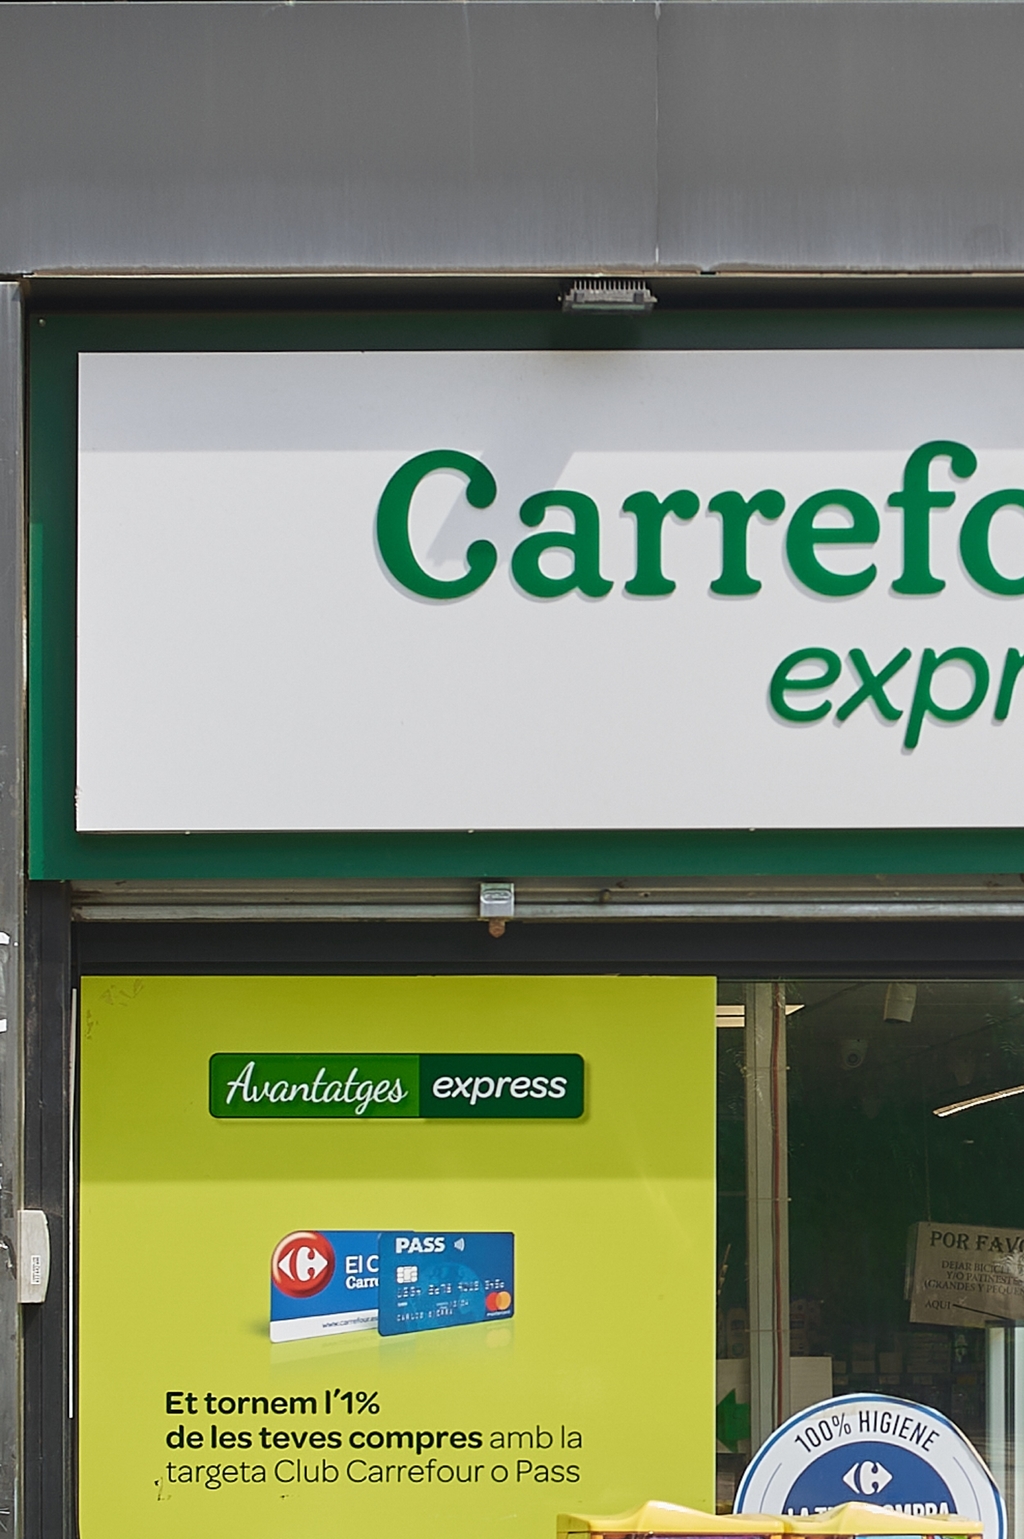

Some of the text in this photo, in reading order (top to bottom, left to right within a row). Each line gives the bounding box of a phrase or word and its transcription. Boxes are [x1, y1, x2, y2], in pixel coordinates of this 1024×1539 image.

[226, 1061, 567, 1115] Avantatges express
[395, 1237, 445, 1254] PASS
[930, 1231, 970, 1251] POR
[346, 1256, 363, 1273] El
[941, 1260, 971, 1271] DEJAR
[946, 1271, 964, 1281] Y/O
[978, 1284, 985, 1293] Y
[166, 1392, 198, 1415] Et
[204, 1393, 317, 1415] tornem
[166, 1425, 583, 1456] de les teves compres amb la
[794, 1410, 941, 1453] 100% HIGIENE
[166, 1459, 581, 1491] targeta Club Carrefour o Pass
